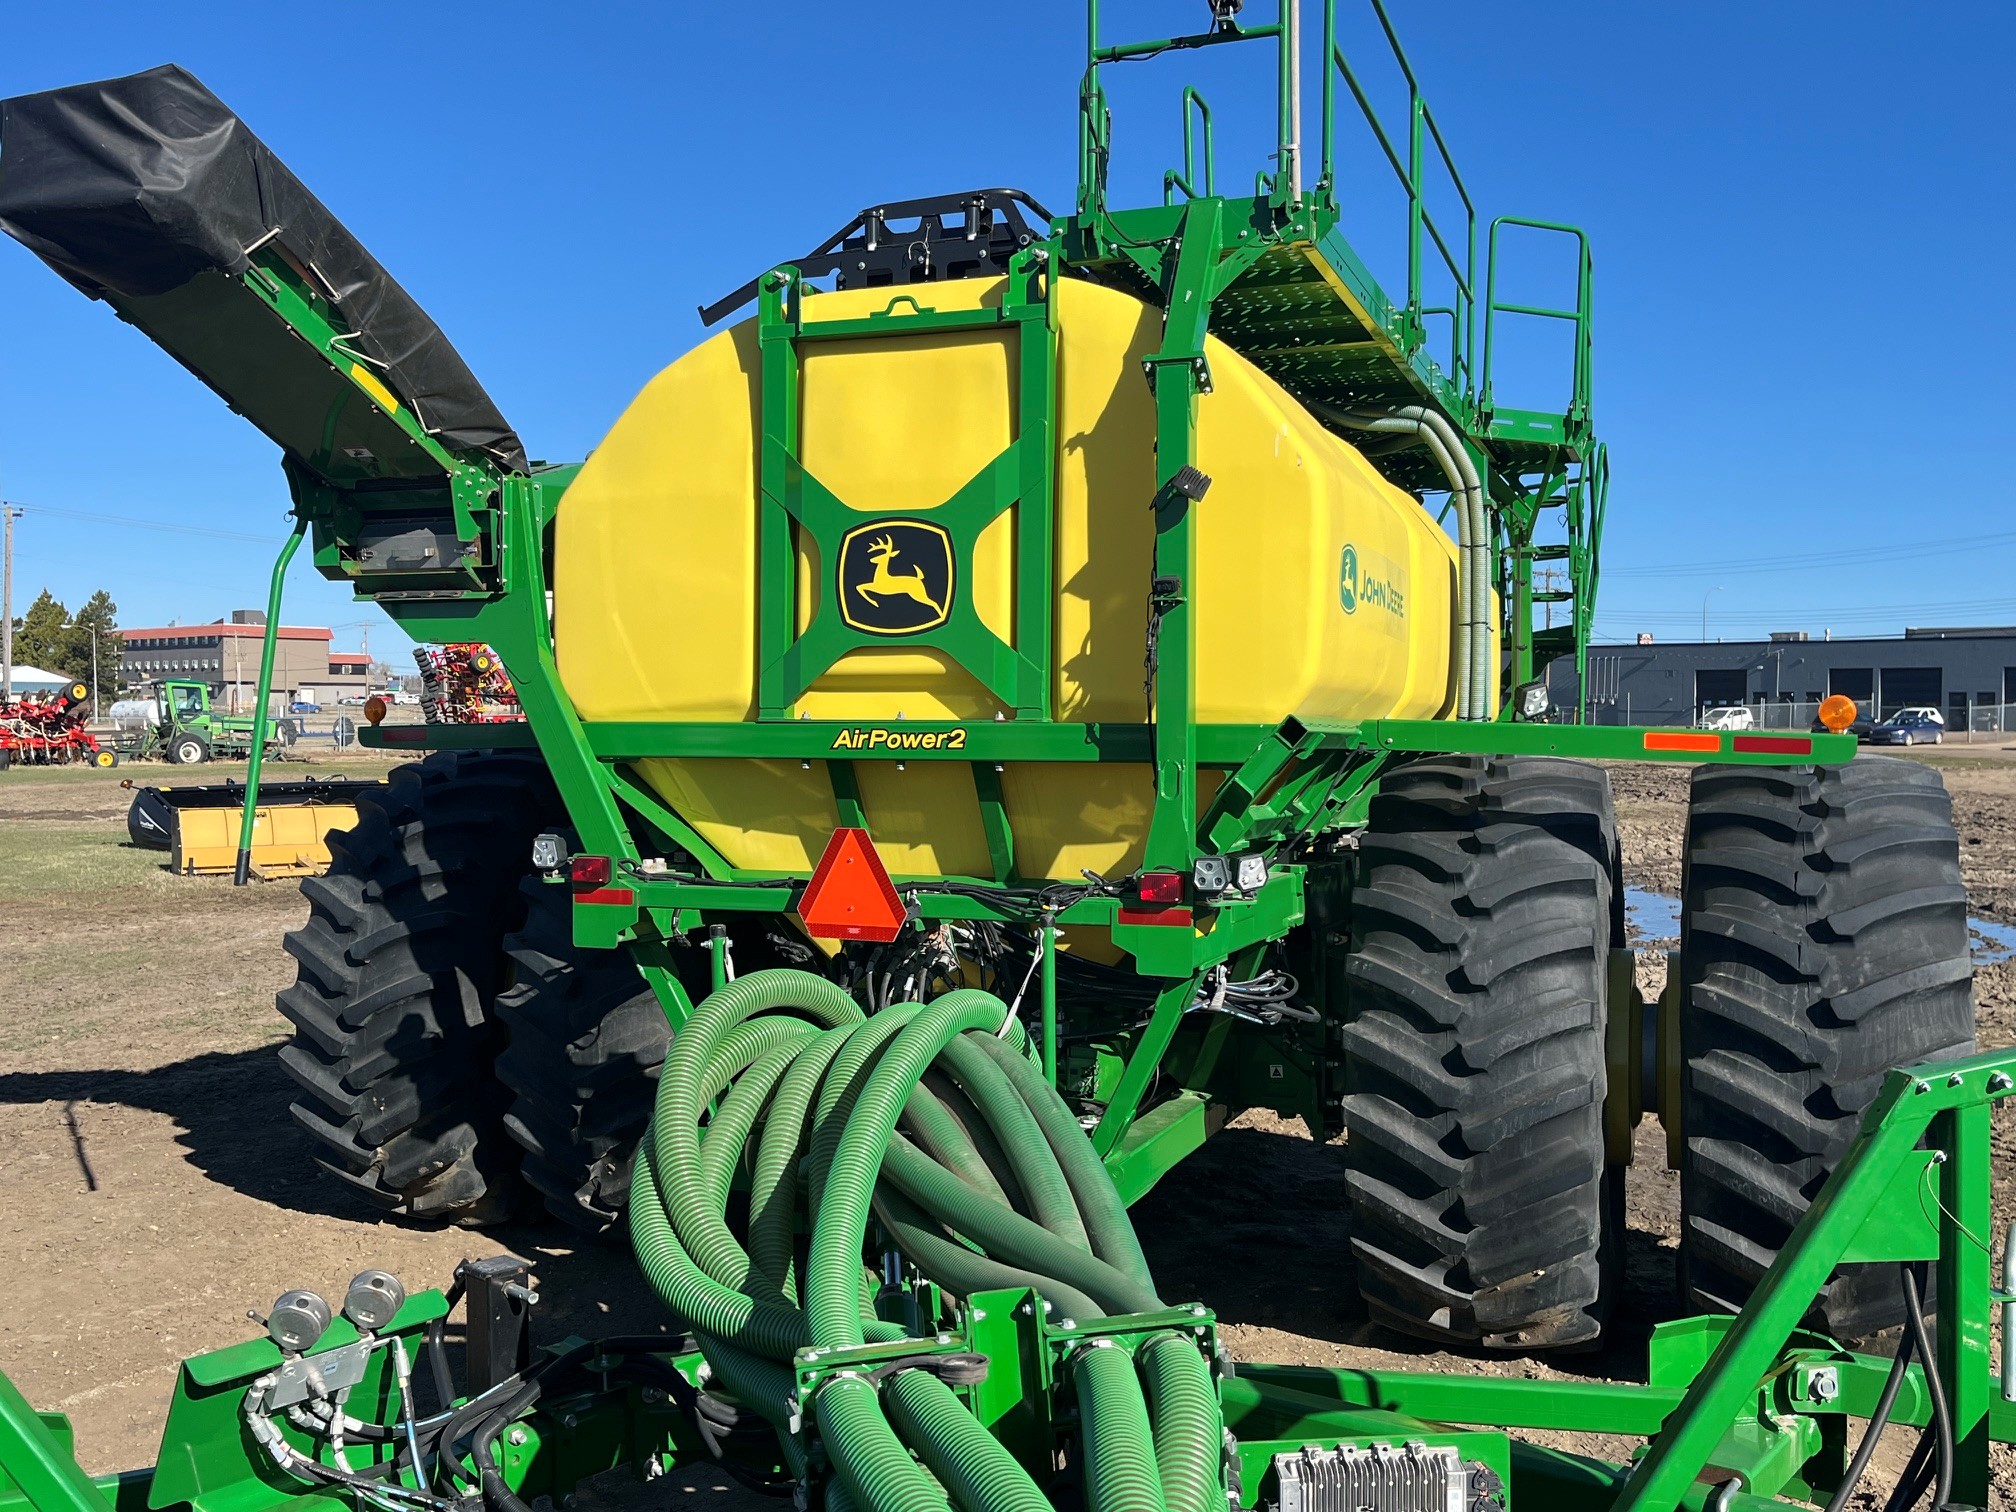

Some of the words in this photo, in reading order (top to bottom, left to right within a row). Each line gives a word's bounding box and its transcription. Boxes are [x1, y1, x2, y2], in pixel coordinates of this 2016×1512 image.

[1360, 569, 1386, 608] JOHN
[1386, 580, 1404, 618] DEERE
[831, 728, 967, 750] AirPower2
